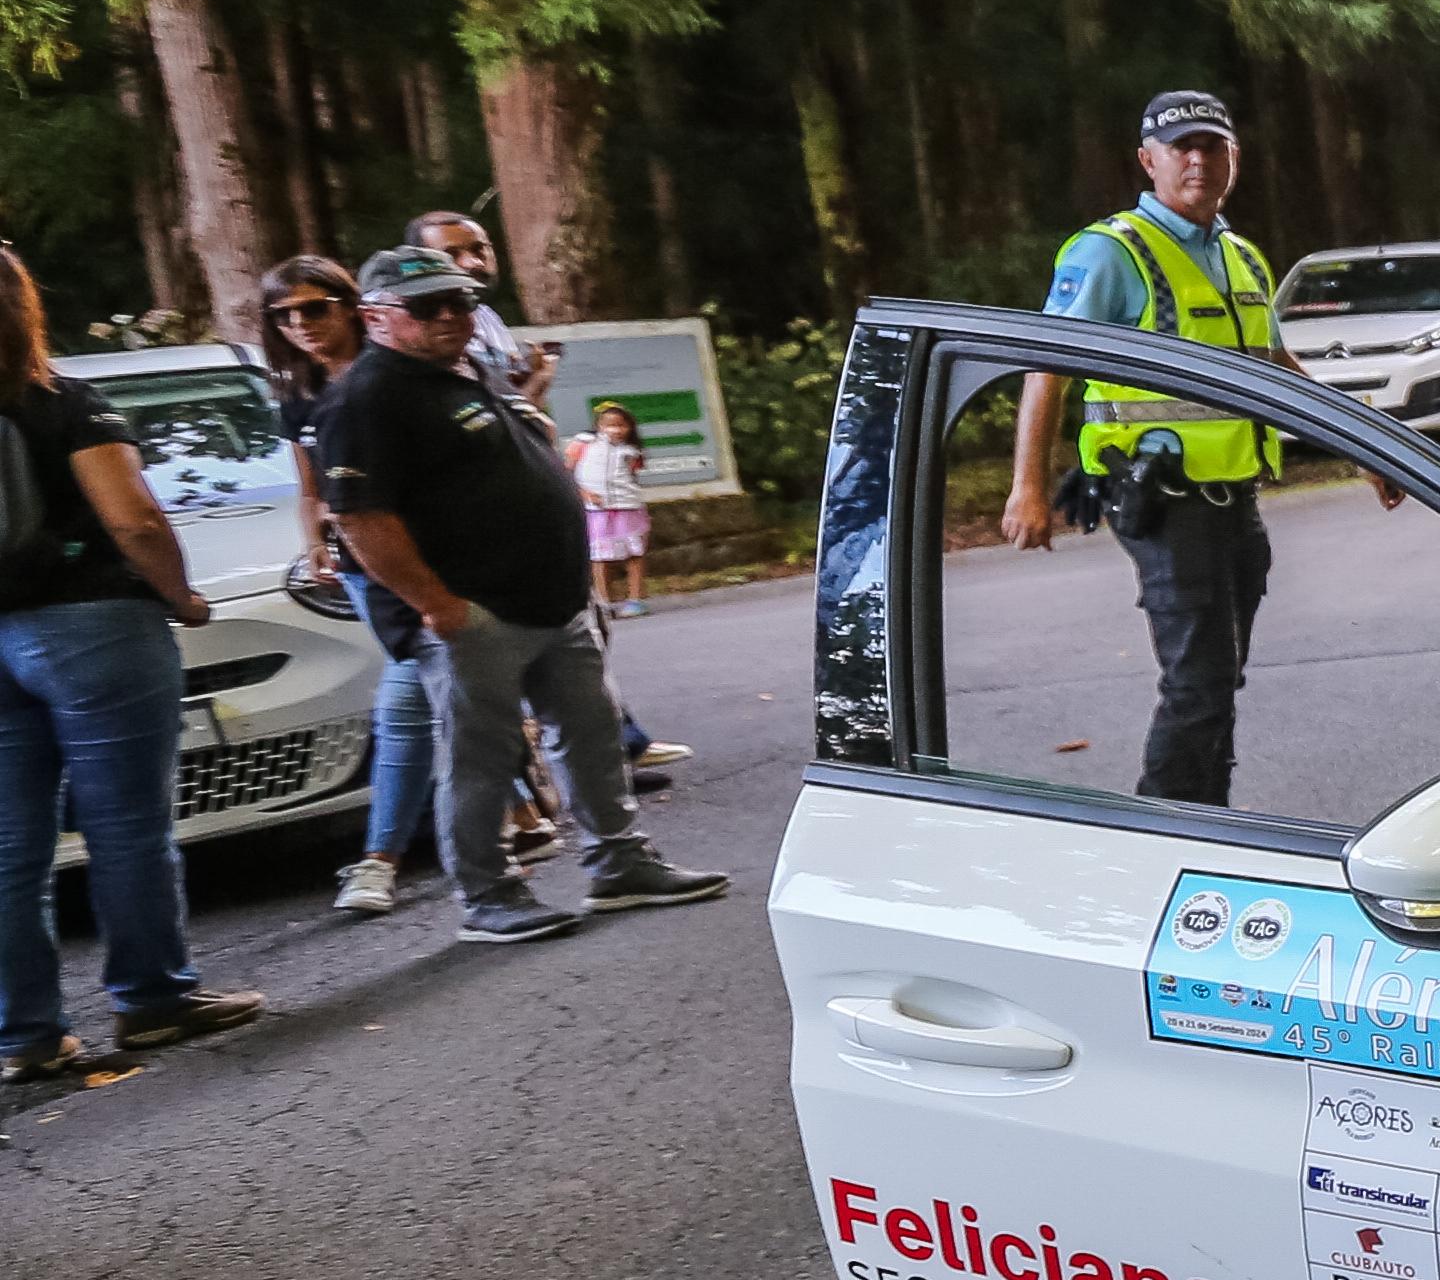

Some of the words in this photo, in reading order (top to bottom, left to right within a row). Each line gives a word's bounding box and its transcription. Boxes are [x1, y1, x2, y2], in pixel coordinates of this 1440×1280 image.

[1188, 912, 1216, 929] TAC
[1249, 921, 1277, 937] TAC
[1315, 1096, 1413, 1133] AÇORES
[1338, 1181, 1430, 1211] transinsular
[1331, 1252, 1416, 1278] CLUBAUTO
